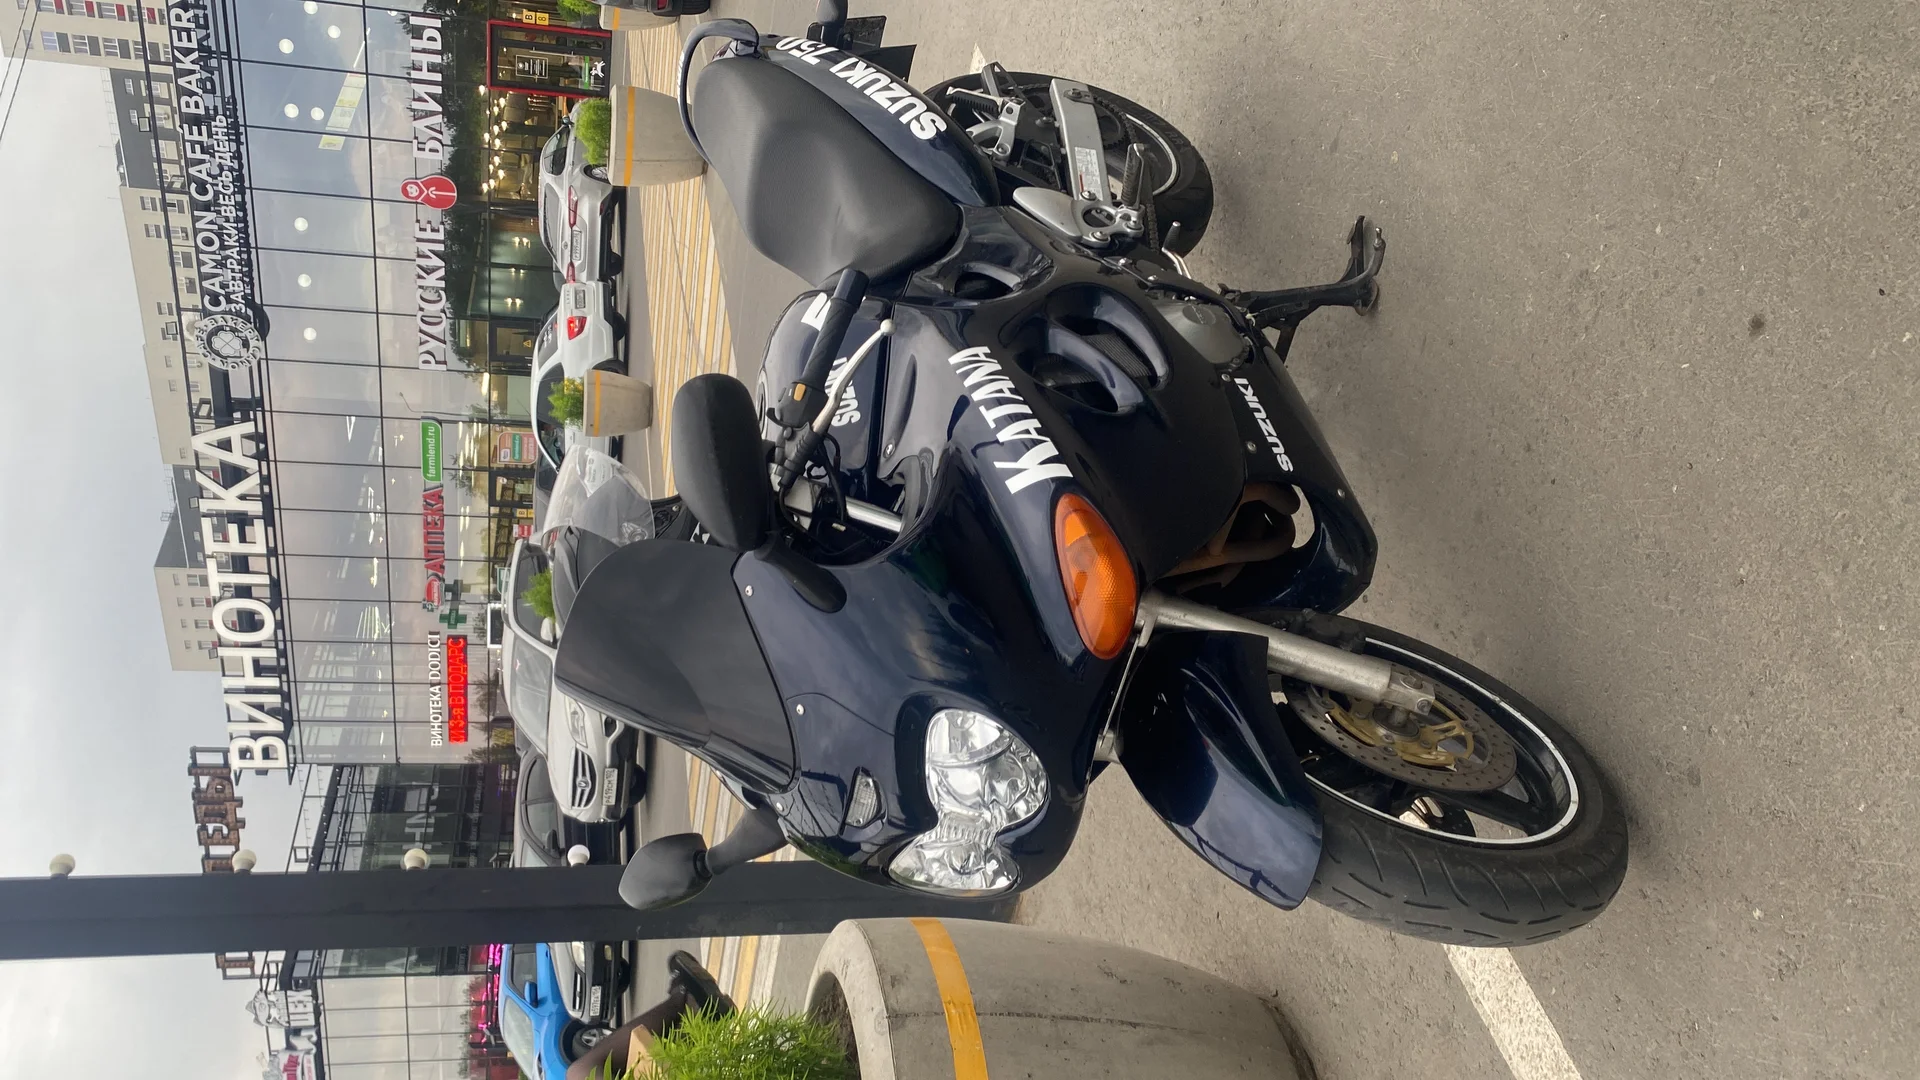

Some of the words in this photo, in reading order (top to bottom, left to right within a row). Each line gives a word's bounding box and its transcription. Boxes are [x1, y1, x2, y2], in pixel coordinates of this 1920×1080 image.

[408, 14, 444, 160] БЛИНЫ
[775, 35, 840, 67] 750
[211, 114, 235, 166] ДЕНЬ
[829, 56, 948, 141] SUZUKI
[177, 122, 214, 202] CAFÉ
[218, 170, 237, 217] ВЕСЬ
[194, 210, 228, 312] CAMON
[221, 221, 247, 313] ЗАВТРАКИ
[414, 221, 448, 370] РУССКИЕ
[425, 425, 437, 478] farmlend.ru
[948, 345, 1074, 495] KATANA
[1234, 377, 1294, 473] SUZUKI
[422, 486, 445, 575] АПТЕКА
[191, 420, 288, 769] ВИНОТЕКА
[427, 633, 441, 680] DODICI
[428, 685, 443, 747] ВИНОТЕКА
[449, 695, 465, 705] В
